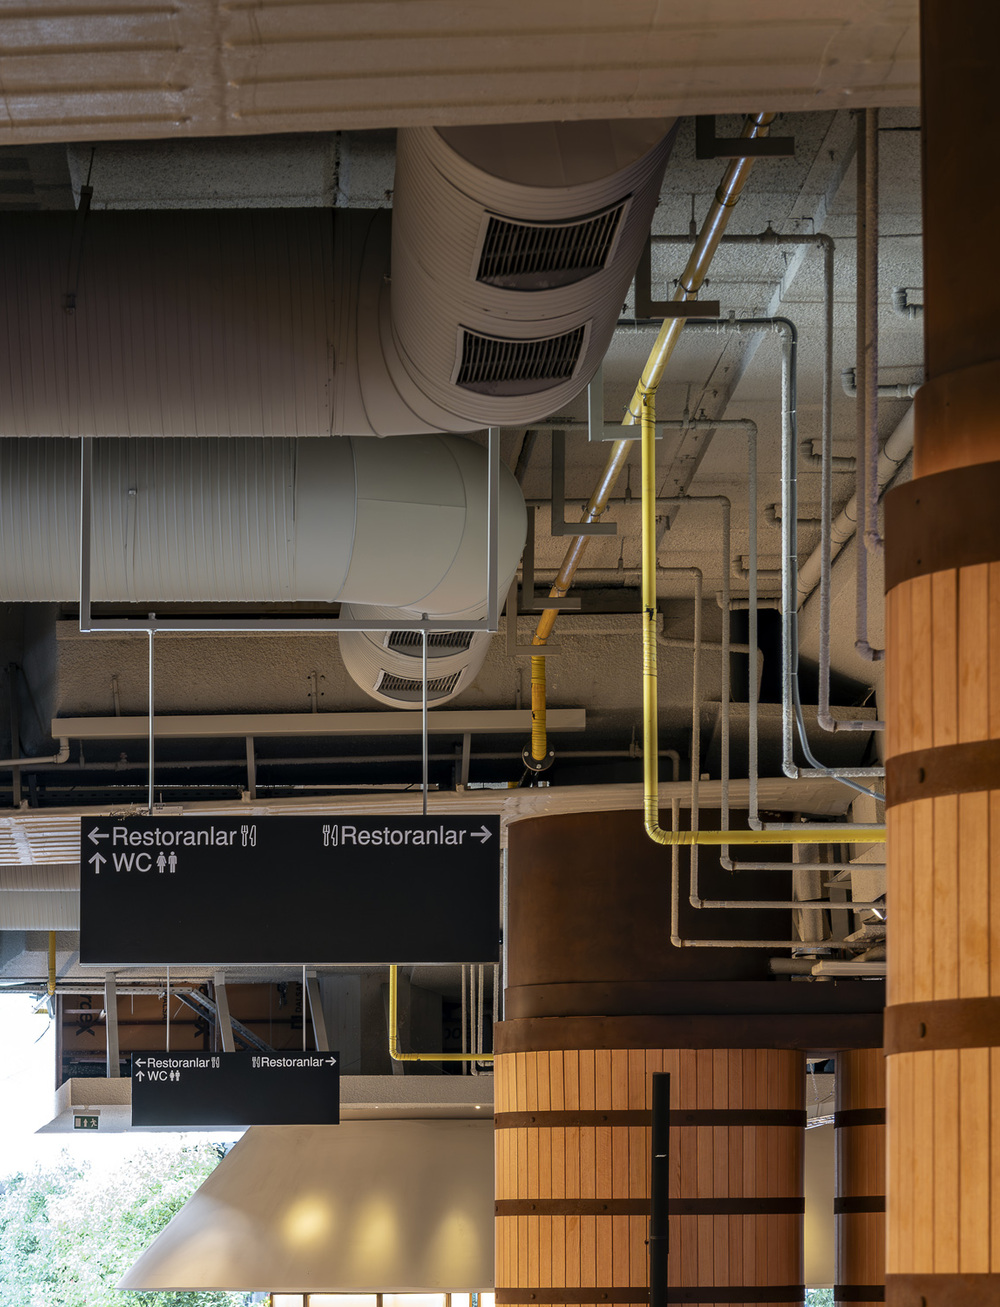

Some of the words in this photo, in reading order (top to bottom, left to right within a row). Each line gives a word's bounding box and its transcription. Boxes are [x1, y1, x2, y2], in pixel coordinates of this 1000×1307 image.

[112, 826, 237, 846] Restoranlar
[341, 825, 467, 845] Restoranlar
[112, 852, 152, 873] WC
[147, 1057, 210, 1068] Restoranlar
[261, 1056, 324, 1067] Restoranlar
[147, 1070, 168, 1082] WC
